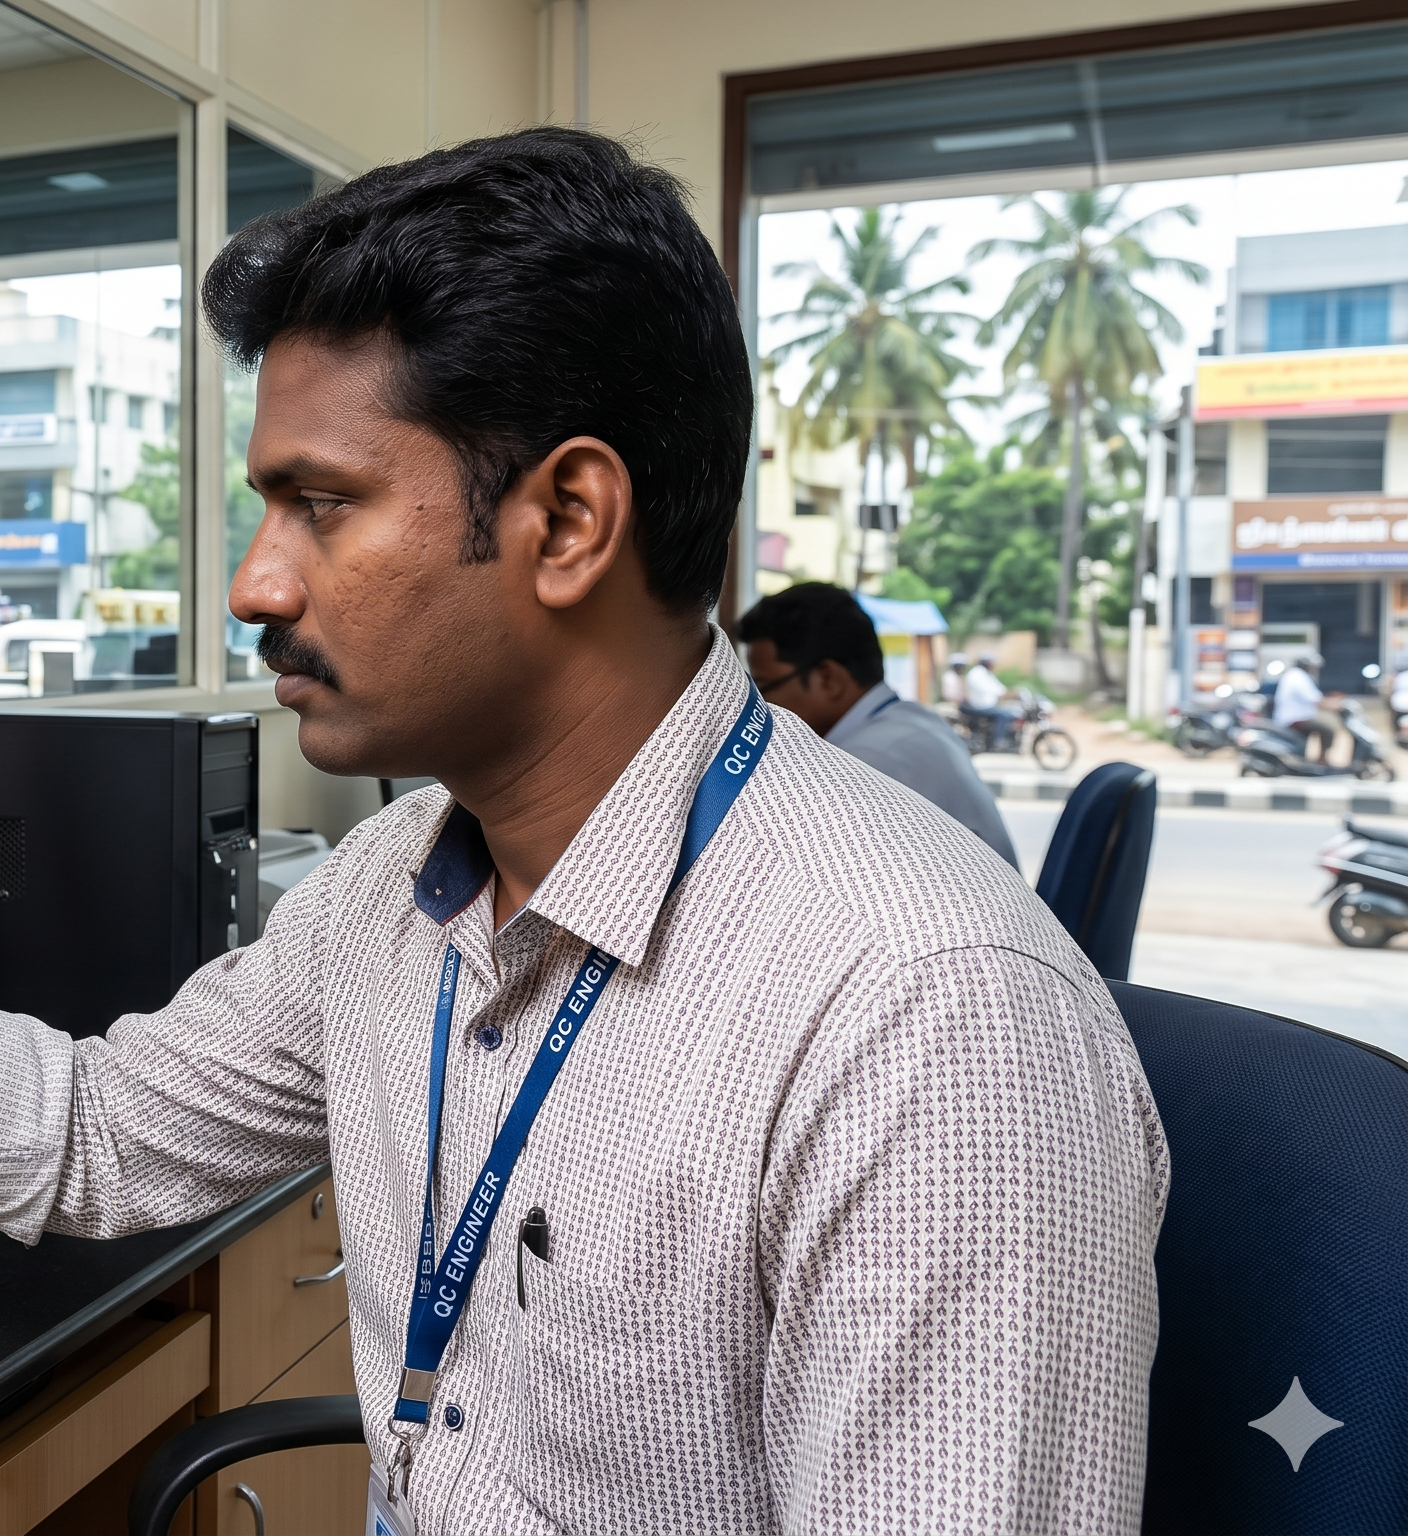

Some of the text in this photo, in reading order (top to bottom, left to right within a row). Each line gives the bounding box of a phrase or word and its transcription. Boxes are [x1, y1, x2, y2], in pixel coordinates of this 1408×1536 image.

[724, 744, 750, 774] QC
[550, 1018, 572, 1052] QC
[434, 1172, 500, 1318] QC ENGINEER
